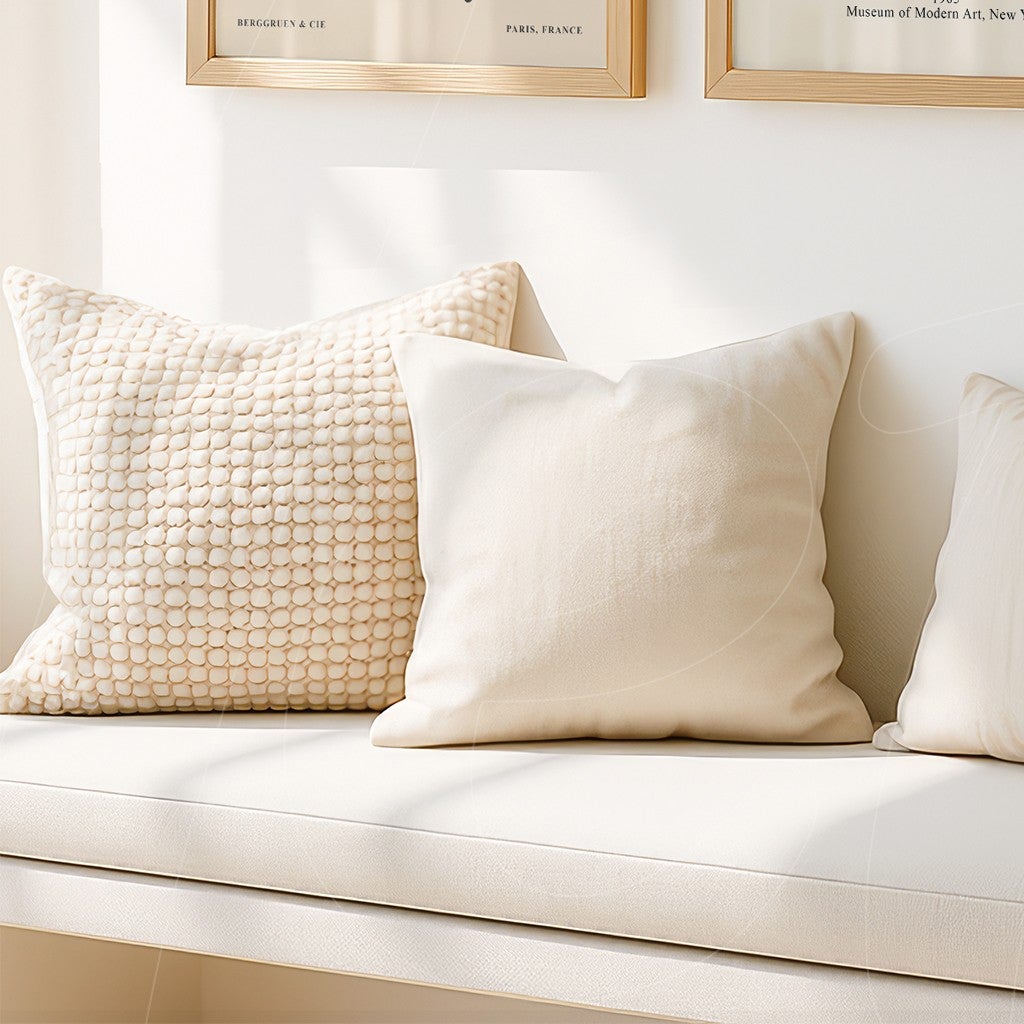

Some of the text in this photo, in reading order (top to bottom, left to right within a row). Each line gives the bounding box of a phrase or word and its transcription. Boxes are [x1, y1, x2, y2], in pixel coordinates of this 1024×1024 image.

[846, 5, 894, 18] Museum
[898, 6, 912, 18] of
[915, 6, 959, 19] Modern
[963, 7, 986, 21] Art,
[989, 8, 1017, 21] New
[237, 18, 327, 29] BERGGRUEN & CIE
[506, 24, 584, 35] PARIS, FRANCE
